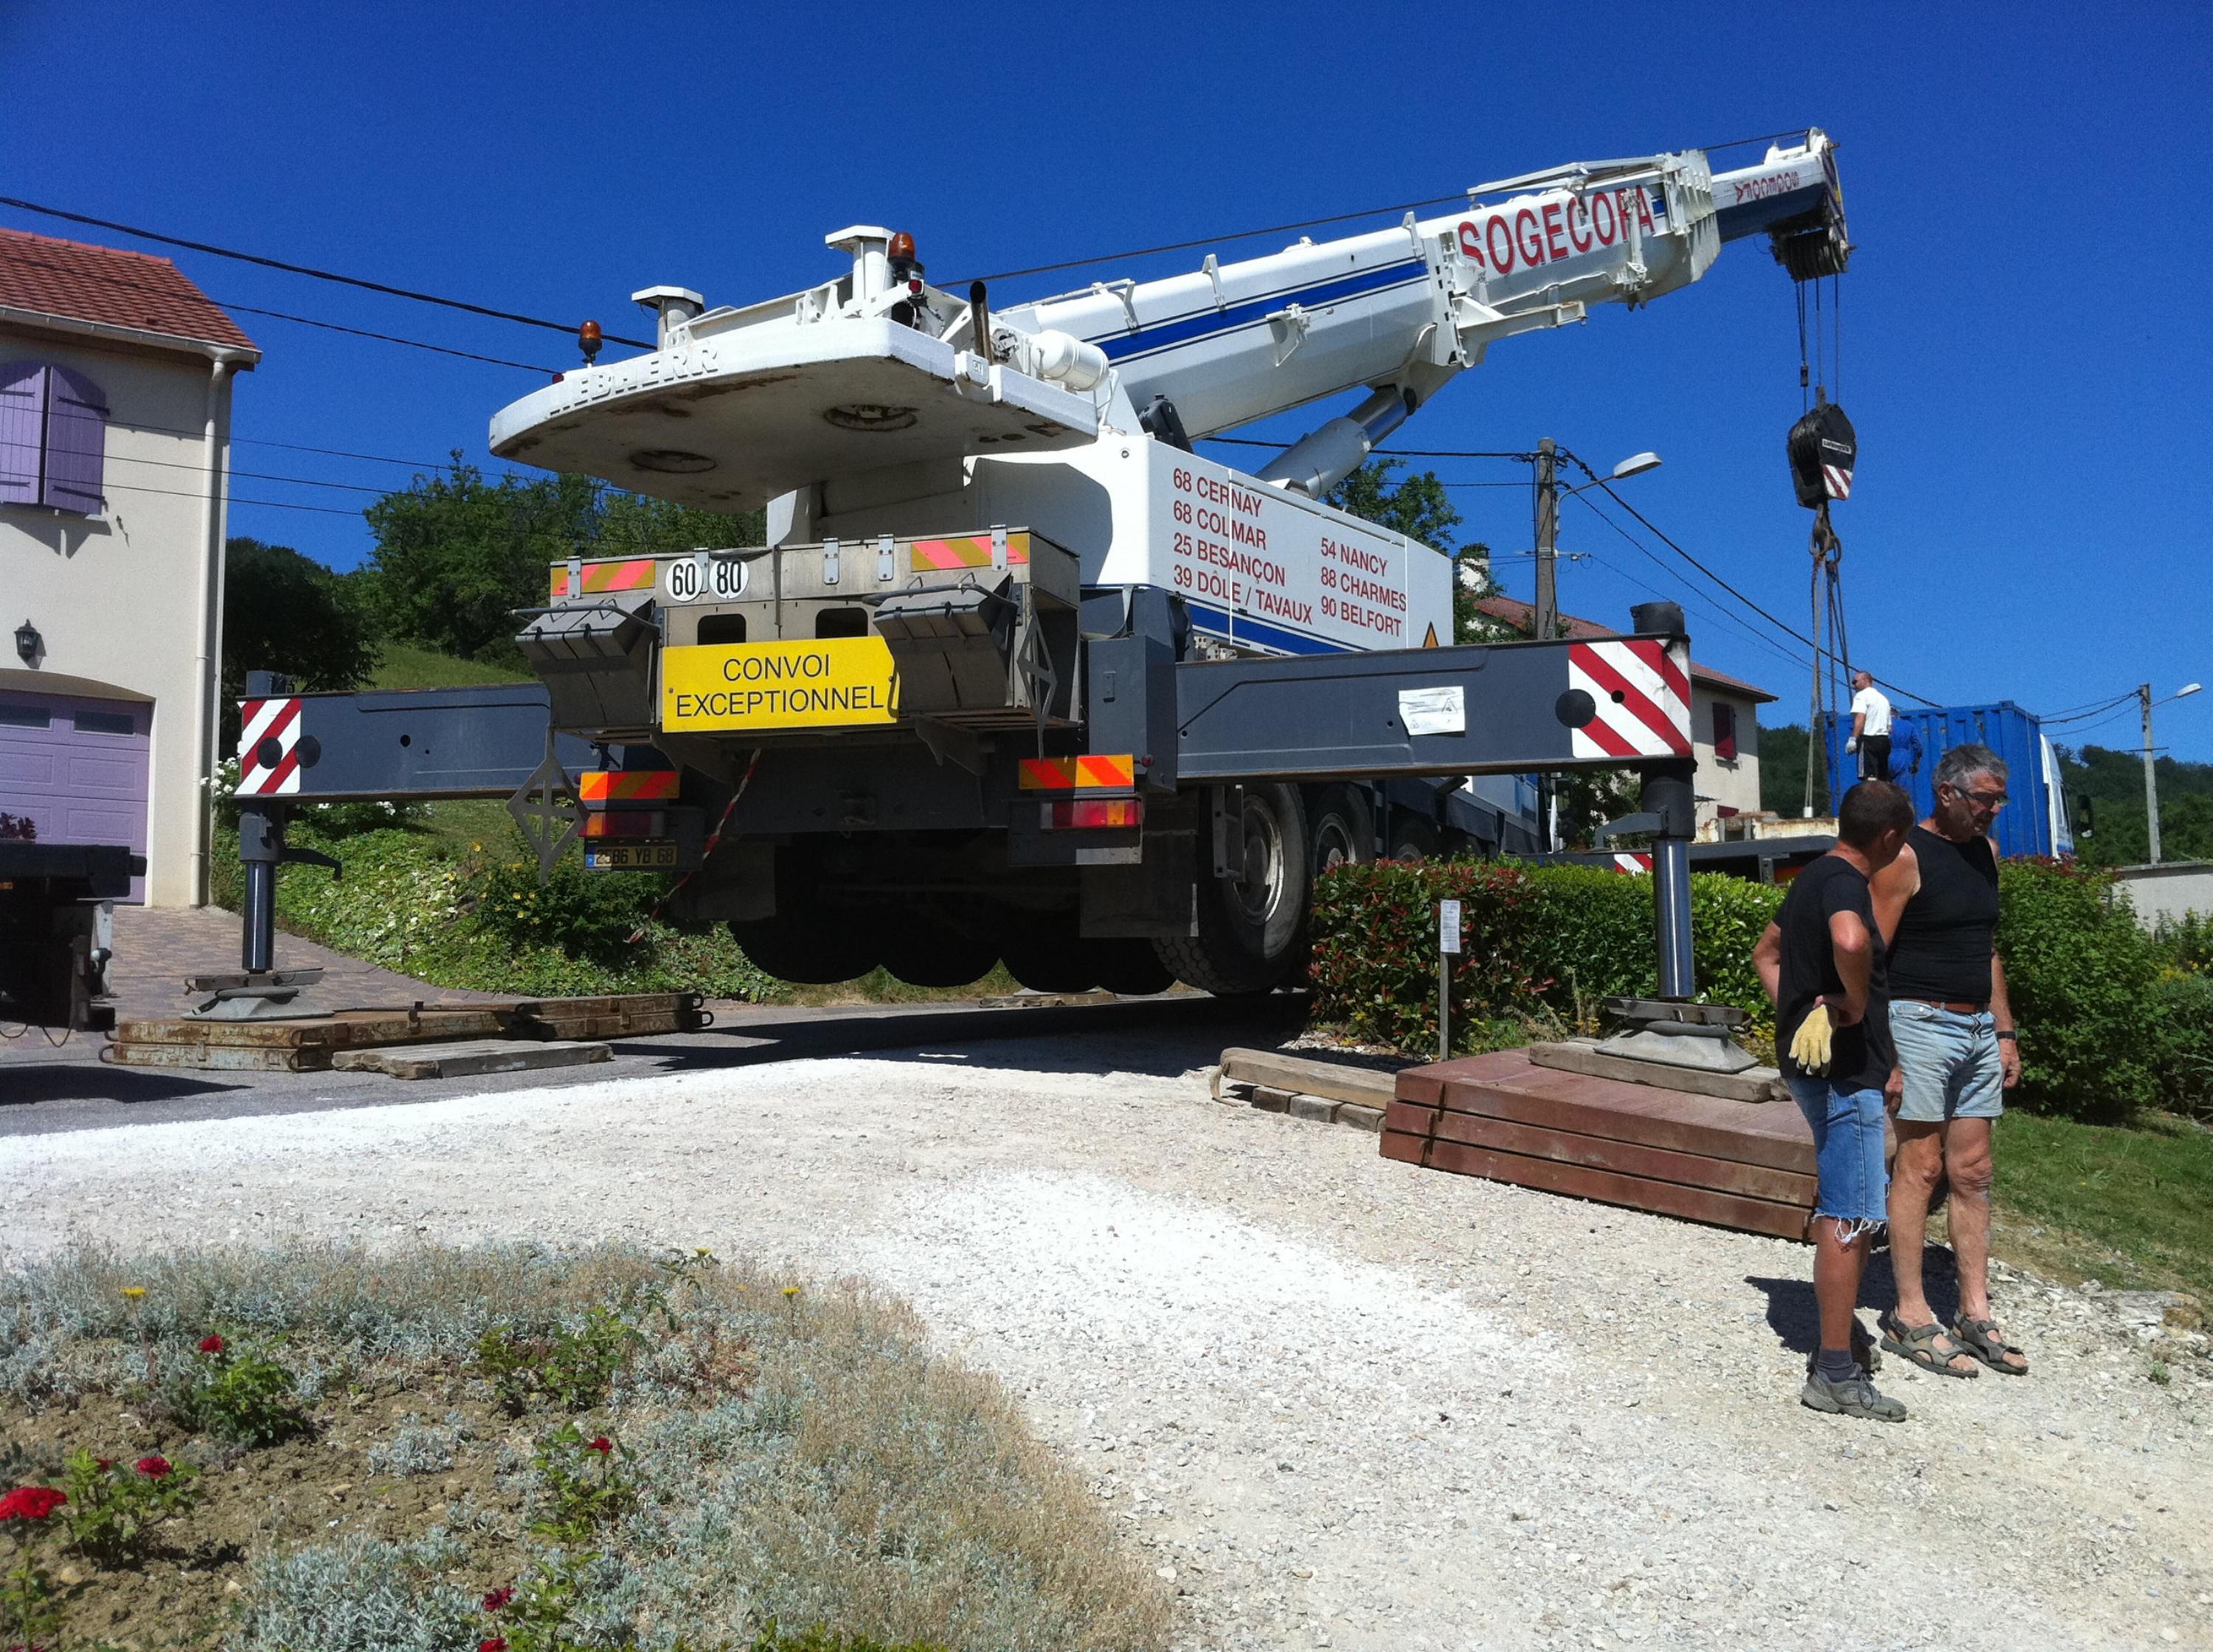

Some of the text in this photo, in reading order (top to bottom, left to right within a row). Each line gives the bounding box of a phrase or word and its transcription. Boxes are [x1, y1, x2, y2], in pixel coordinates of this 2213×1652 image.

[1458, 184, 1655, 275] SOGECOFA
[550, 342, 718, 415] EBHERR
[1174, 468, 1262, 518] 68 CERNAY
[1174, 499, 1267, 550] 68 COLMAR
[671, 562, 696, 595] 60
[716, 560, 741, 593] 80
[1174, 532, 1286, 586] 25 BESANÇON
[1321, 537, 1388, 577] 54 NANCY
[1174, 563, 1313, 625] 39 DÔLE / TAVAUX
[1321, 566, 1407, 612] 88 CHARMES
[1321, 595, 1402, 637] 90 BELFORT
[723, 653, 831, 681] CONVOI
[676, 686, 884, 718] EXCEPTIONNEL
